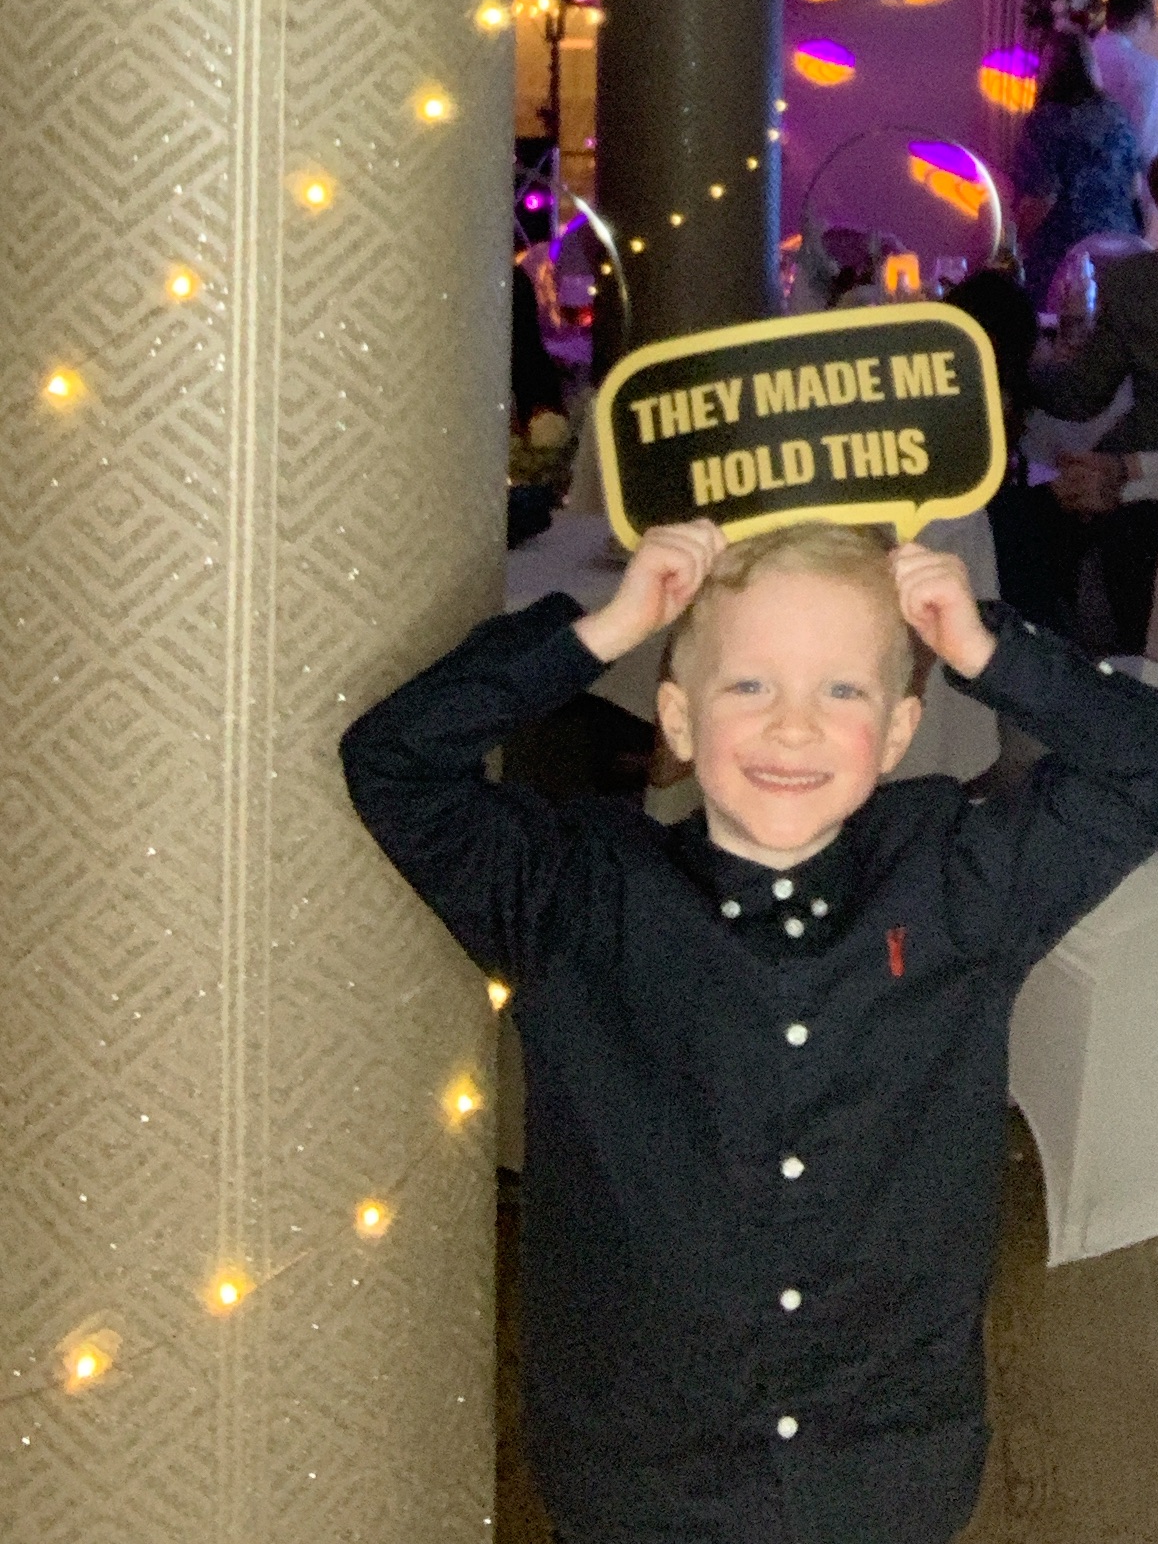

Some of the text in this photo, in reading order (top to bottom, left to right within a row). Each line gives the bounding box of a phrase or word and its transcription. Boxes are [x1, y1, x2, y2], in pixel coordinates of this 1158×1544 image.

[631, 351, 960, 445] THEY MADE ME
[691, 428, 930, 507] HOLD THIS
